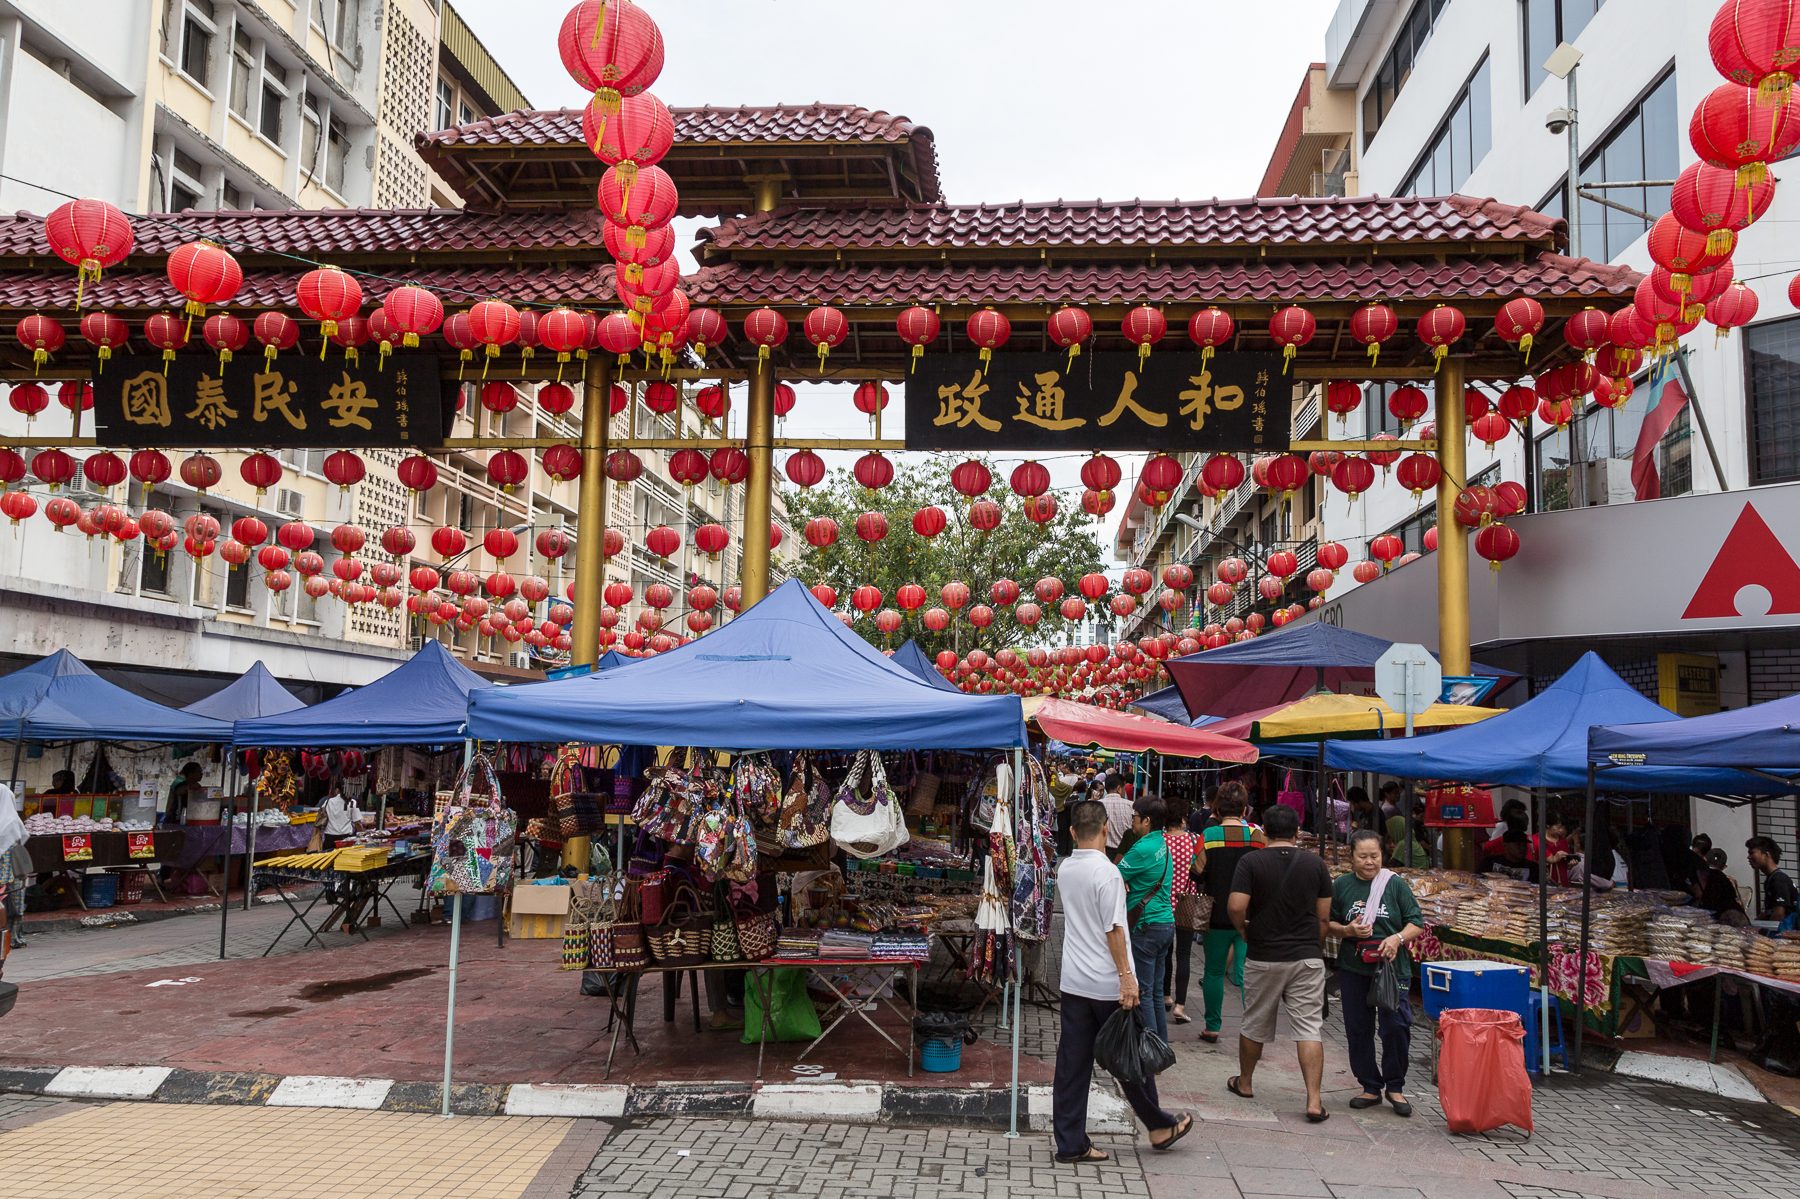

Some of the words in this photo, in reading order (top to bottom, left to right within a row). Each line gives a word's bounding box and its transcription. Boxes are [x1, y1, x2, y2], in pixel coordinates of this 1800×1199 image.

[122, 370, 379, 430] 國泰民安
[933, 369, 1244, 432] 政通人和
